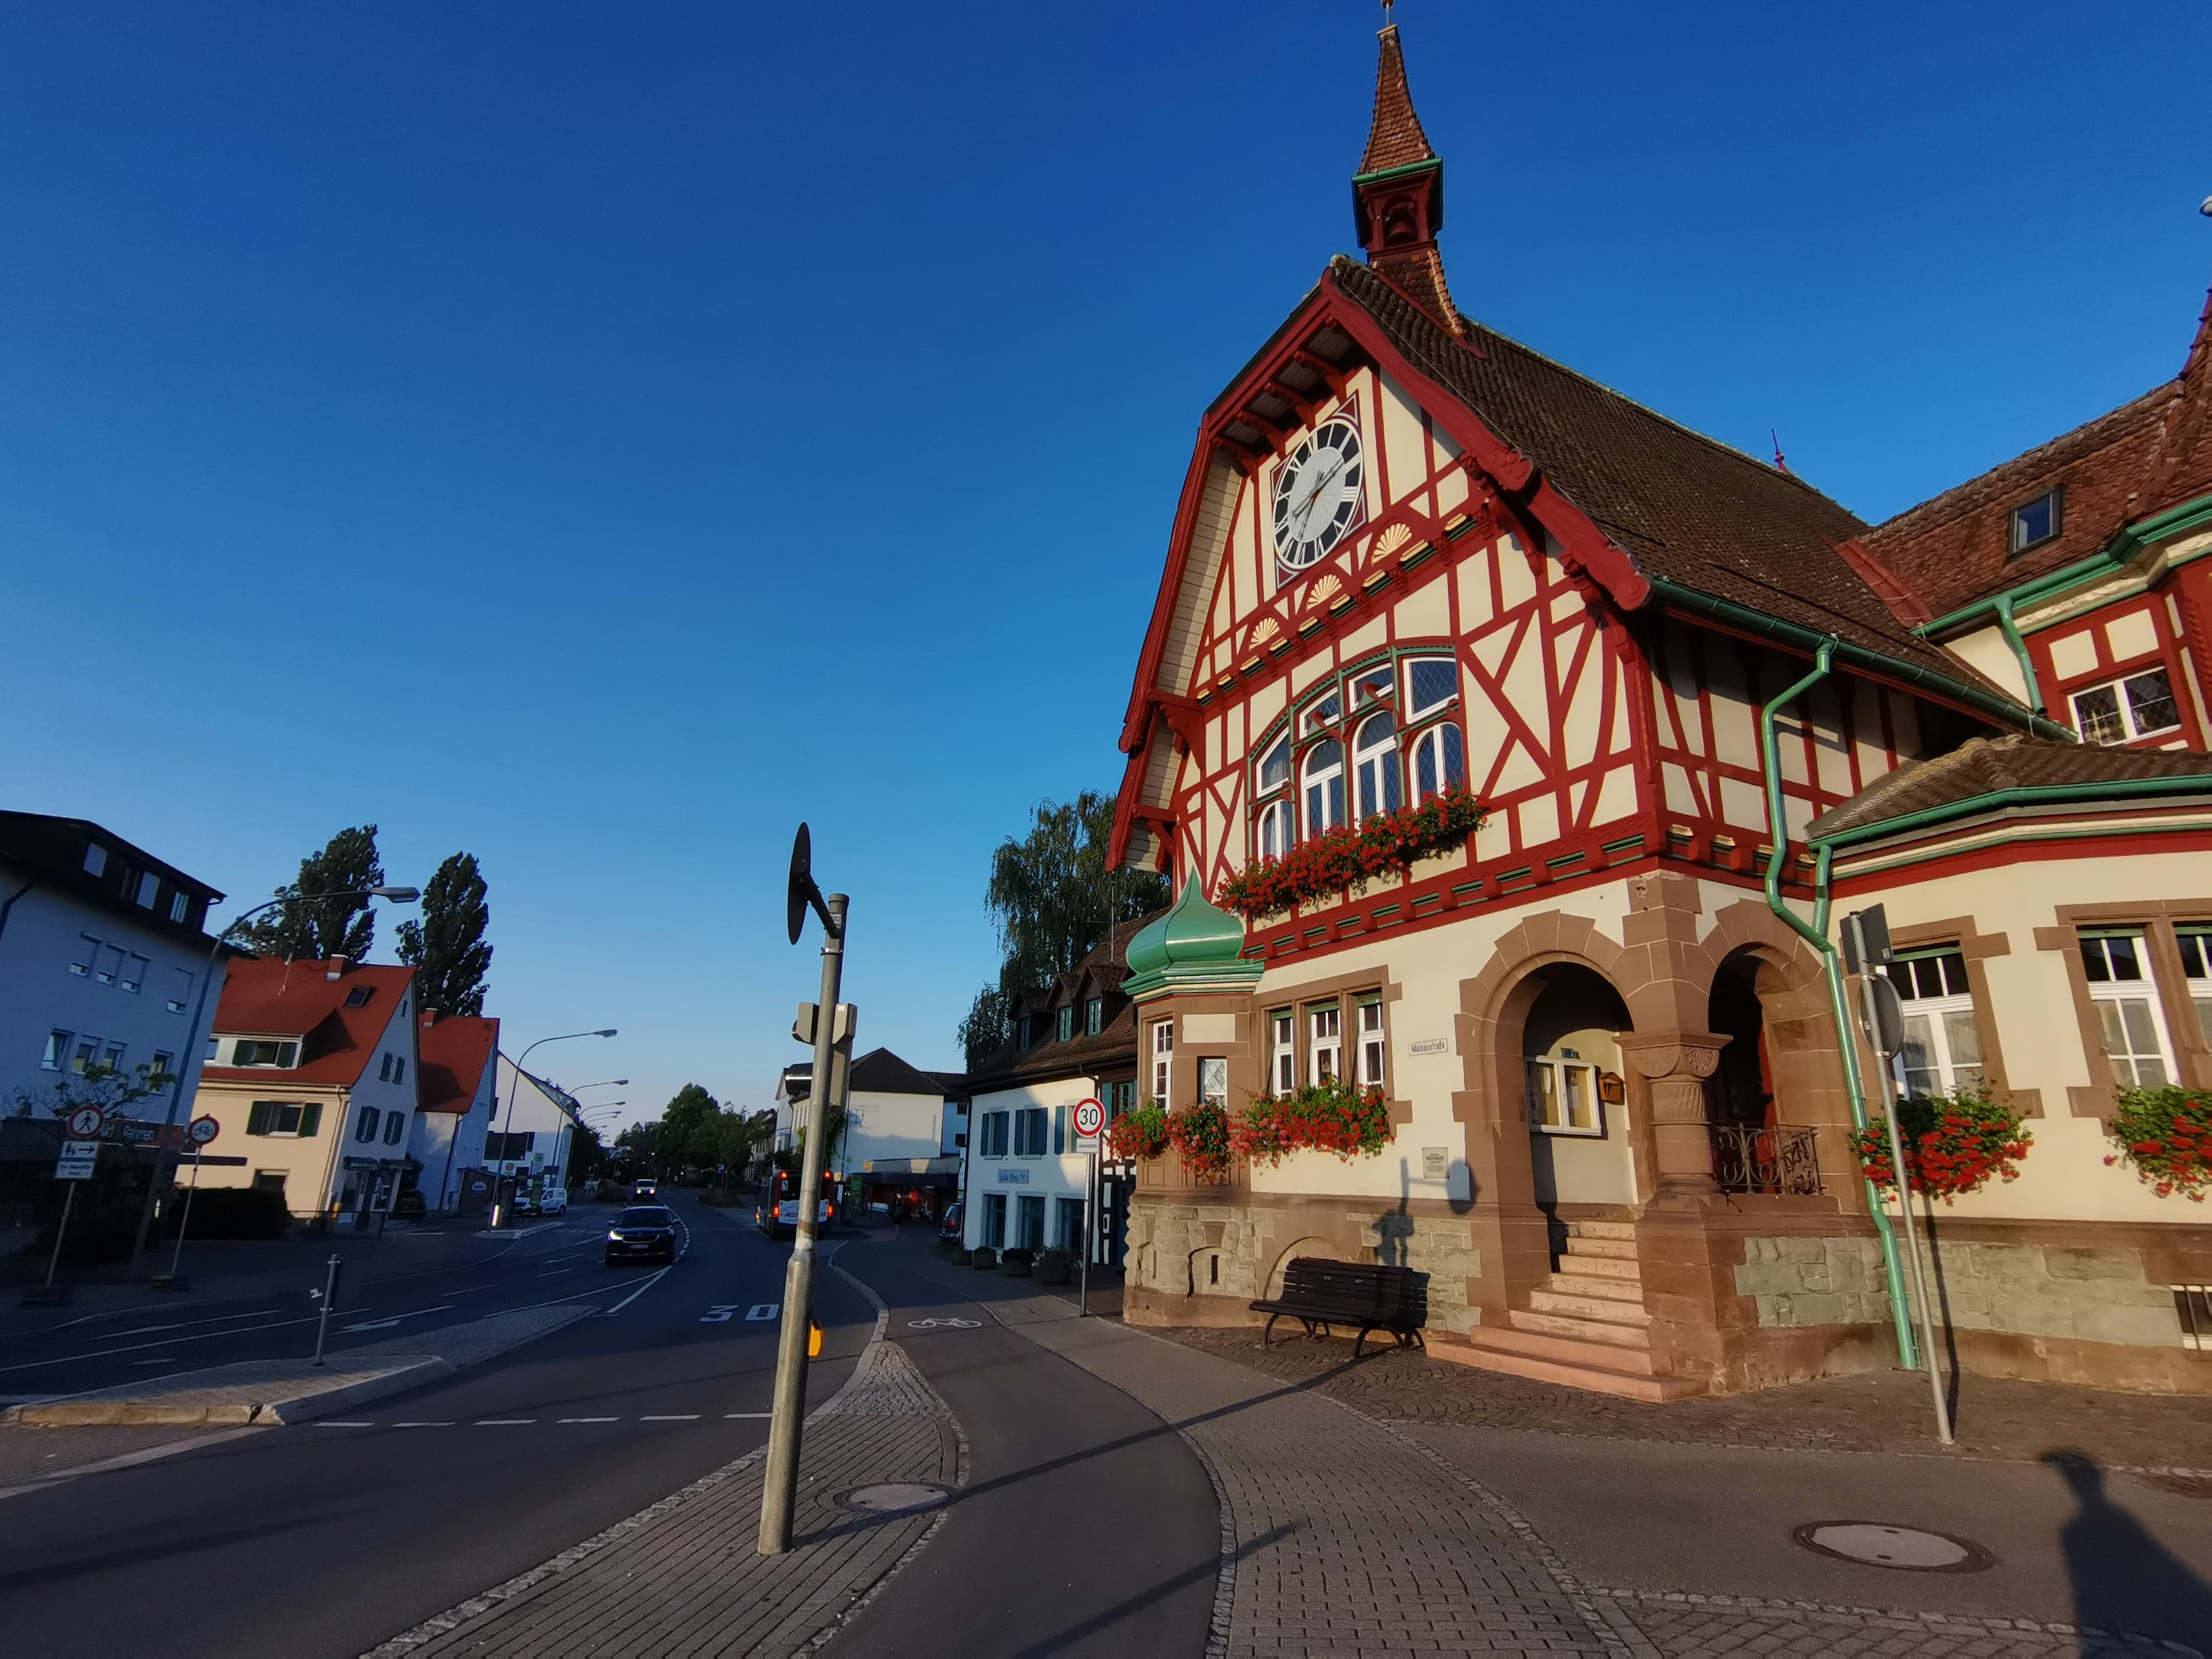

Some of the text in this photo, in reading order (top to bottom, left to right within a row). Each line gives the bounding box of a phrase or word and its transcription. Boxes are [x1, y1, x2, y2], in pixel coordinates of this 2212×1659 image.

[1411, 1040, 1446, 1052] Mainaustraße
[1080, 1108, 1098, 1126] 30
[699, 1304, 780, 1322] 30
